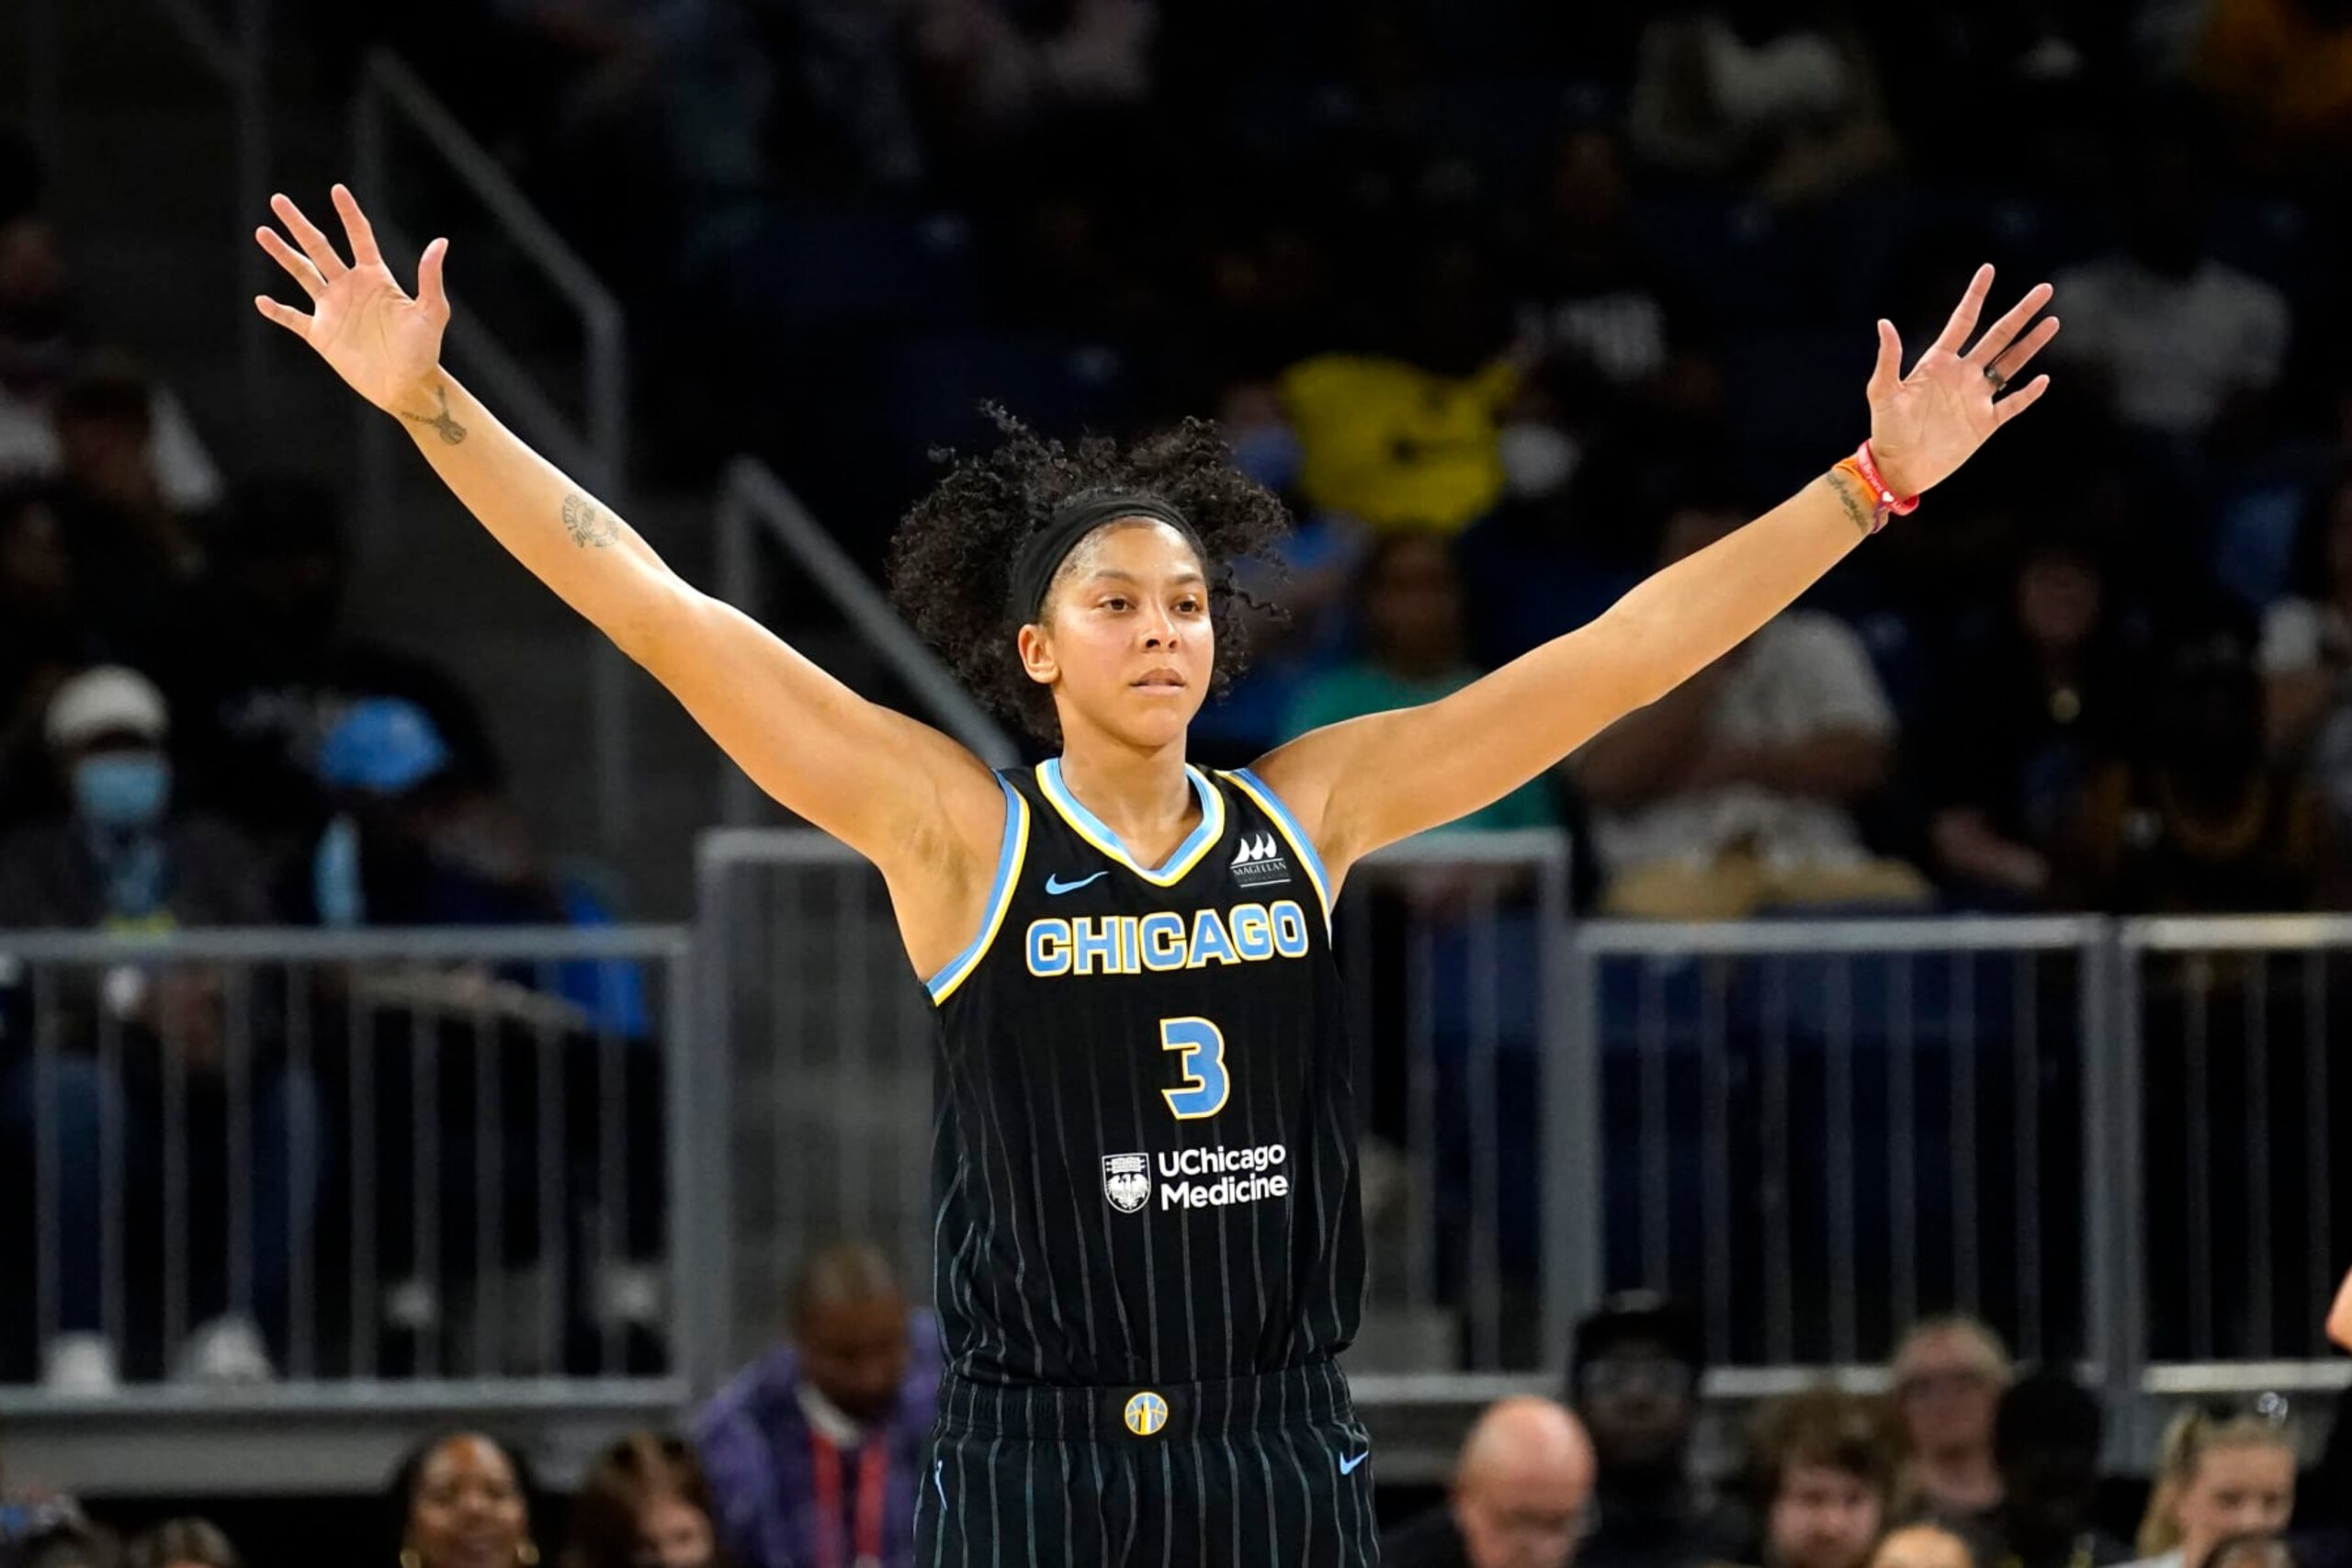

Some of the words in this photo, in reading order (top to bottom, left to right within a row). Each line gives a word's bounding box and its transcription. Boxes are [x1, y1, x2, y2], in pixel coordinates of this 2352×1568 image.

[1232, 861, 1287, 876] MAGELLAN
[1025, 899, 1309, 977] CHICAGO
[1159, 1016, 1230, 1121] 3
[1158, 1144, 1286, 1177] UChicago
[1159, 1172, 1289, 1211] Medicine
